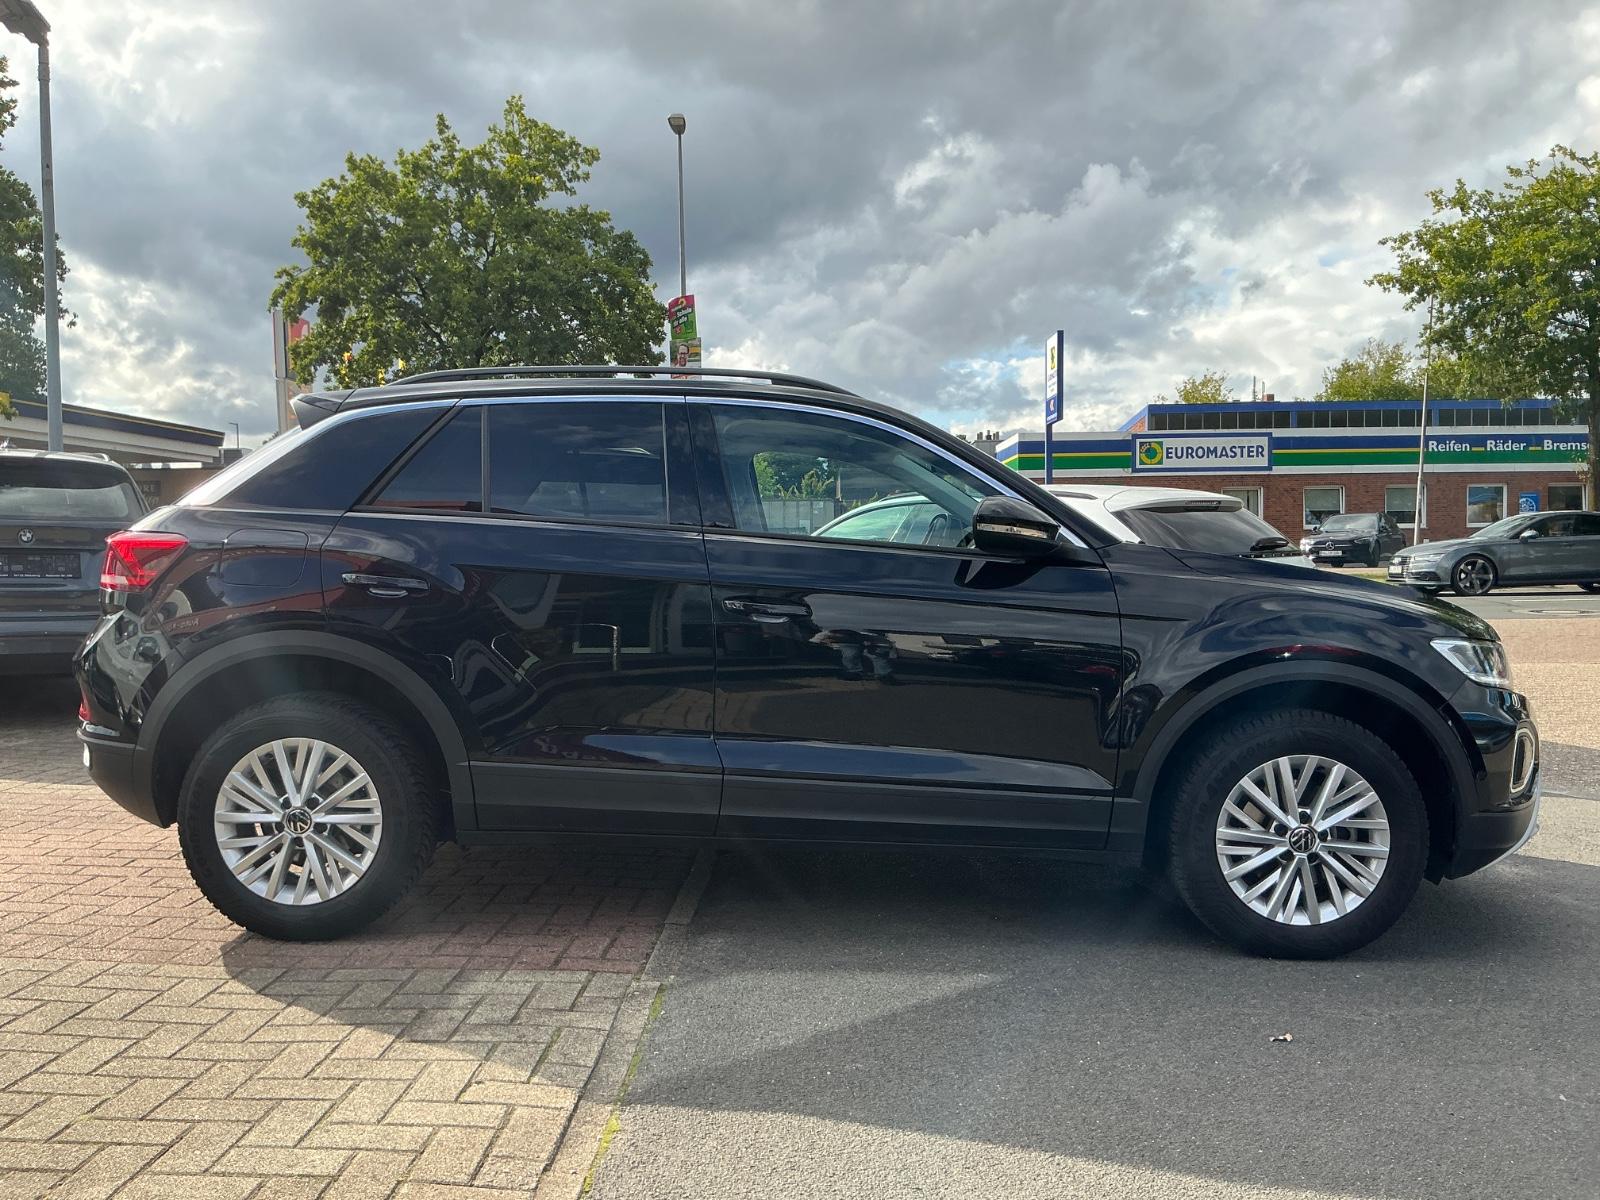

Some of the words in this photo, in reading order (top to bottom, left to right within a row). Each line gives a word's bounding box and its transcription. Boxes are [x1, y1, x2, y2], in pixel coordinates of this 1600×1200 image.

[1165, 444, 1265, 460] EUROMASTER
[1428, 440, 1470, 452] Reifen
[1486, 439, 1526, 451] Räder
